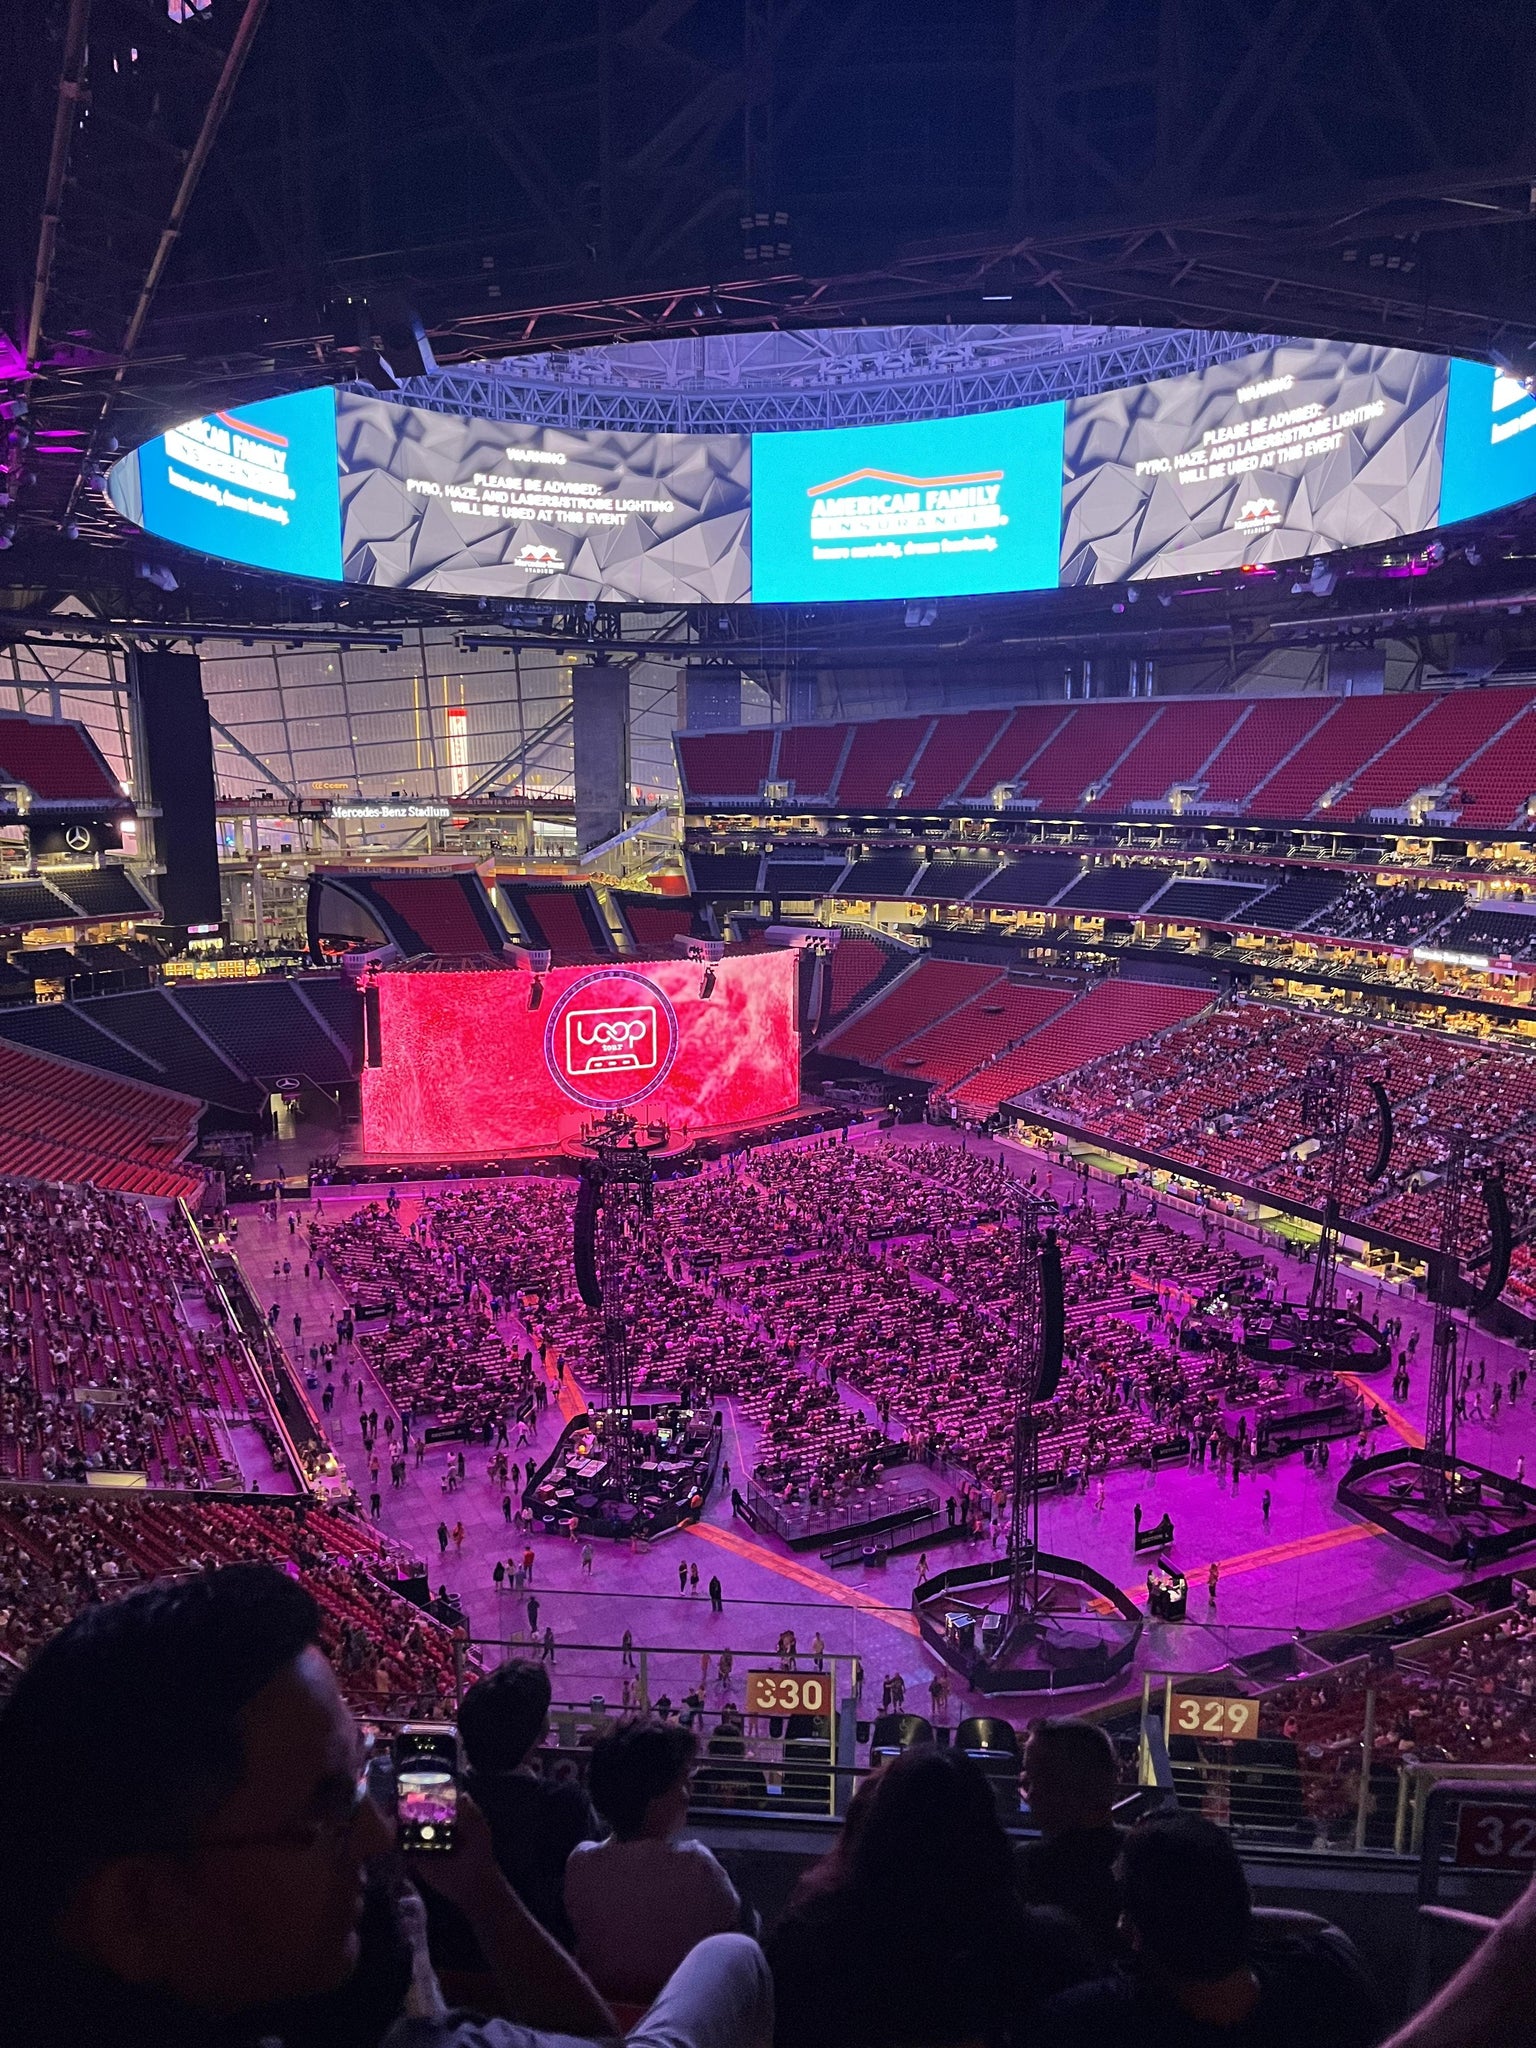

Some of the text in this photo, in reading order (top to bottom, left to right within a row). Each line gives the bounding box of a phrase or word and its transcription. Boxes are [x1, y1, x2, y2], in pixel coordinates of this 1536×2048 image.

[1236, 374, 1295, 404] WARNING
[1135, 457, 1172, 477] PYRO,
[1174, 451, 1208, 470] HAZE,
[1209, 445, 1236, 463] AND
[1332, 399, 1386, 430] LIGHTING
[1203, 402, 1325, 446] PLEASE BE ADVISED:
[505, 448, 567, 465] WARNING
[1178, 431, 1345, 484] WILL BE USED AT THIS EVENT
[406, 479, 442, 498] PYRO,
[445, 484, 480, 502] HAZE,
[482, 491, 510, 504] AND
[615, 500, 675, 513] LIGHTING
[473, 473, 602, 496] PLEASE BE ADVISED:
[811, 484, 1001, 517] AMERICAN FAMILY
[451, 501, 628, 525] WILL BE USED AT THIS EVENT
[331, 806, 450, 818] Mercedes-Benz Stadium
[757, 1678, 822, 1710] 330
[1179, 1699, 1249, 1733] 329
